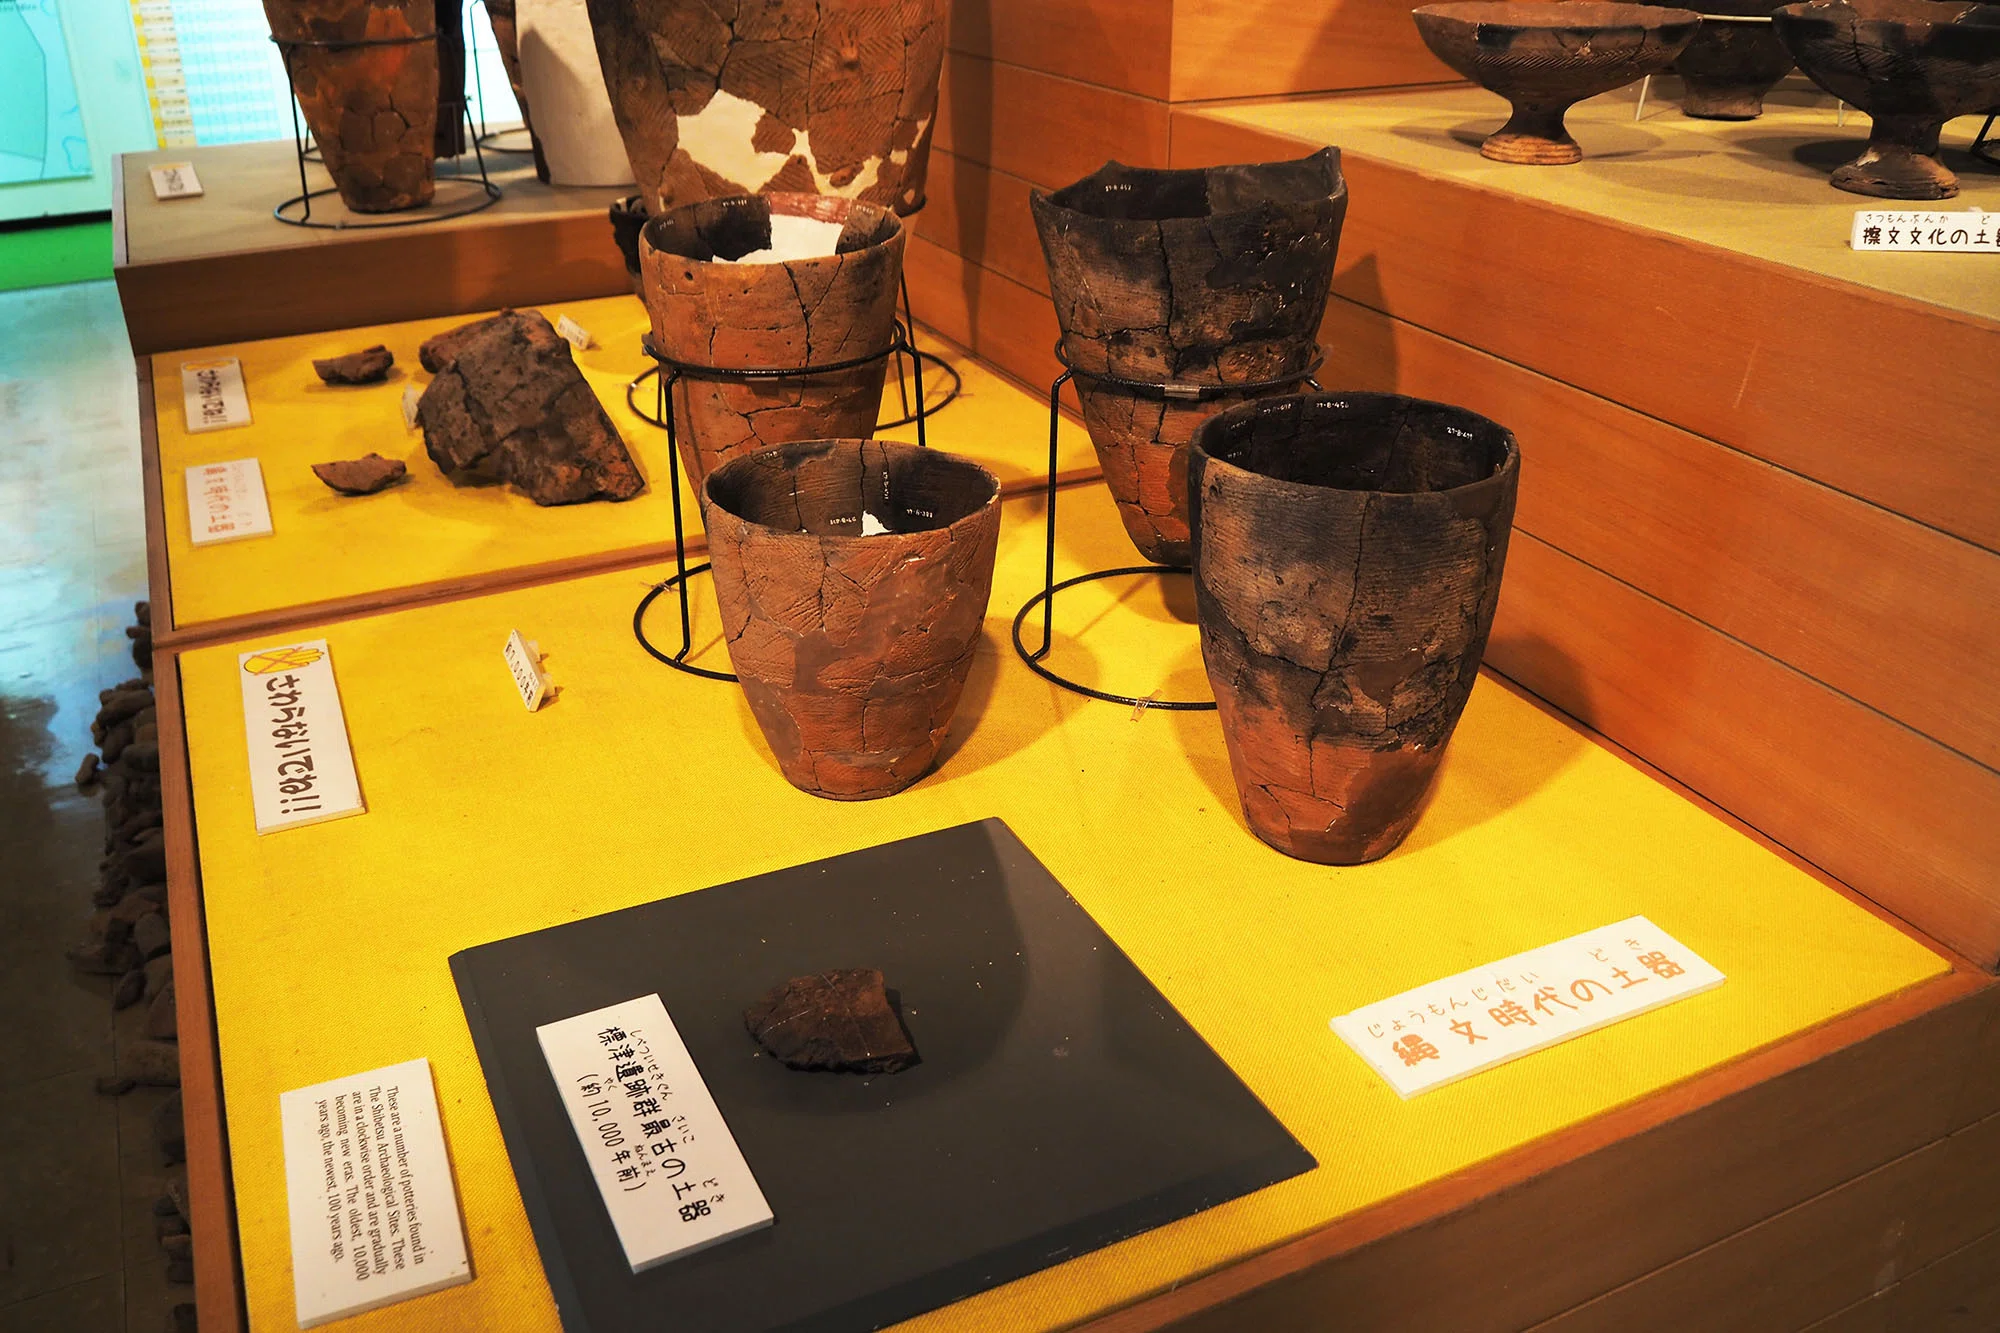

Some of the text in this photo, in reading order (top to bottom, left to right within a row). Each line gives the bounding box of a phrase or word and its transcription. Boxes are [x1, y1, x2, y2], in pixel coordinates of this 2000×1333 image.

[352, 1091, 362, 1105] are
[387, 1086, 400, 1111] These
[335, 1094, 350, 1137] becoming
[390, 1112, 401, 1126] are
[340, 1138, 352, 1157] new
[356, 1122, 372, 1163] clockwise
[394, 1133, 410, 1168] number
[315, 1100, 345, 1263] years ago, the newest, 100 years ago.
[343, 1161, 355, 1183] eras.
[362, 1164, 377, 1190] order
[369, 1086, 406, 1272] The Shibetsu Archaeological Sites. These
[346, 1184, 360, 1205] The
[366, 1192, 381, 1210] and
[398, 1180, 419, 1223] potteries
[368, 1210, 380, 1227] are
[367, 1228, 389, 1275] gradually
[409, 1222, 427, 1253] found
[353, 1245, 371, 1281] 10,000
